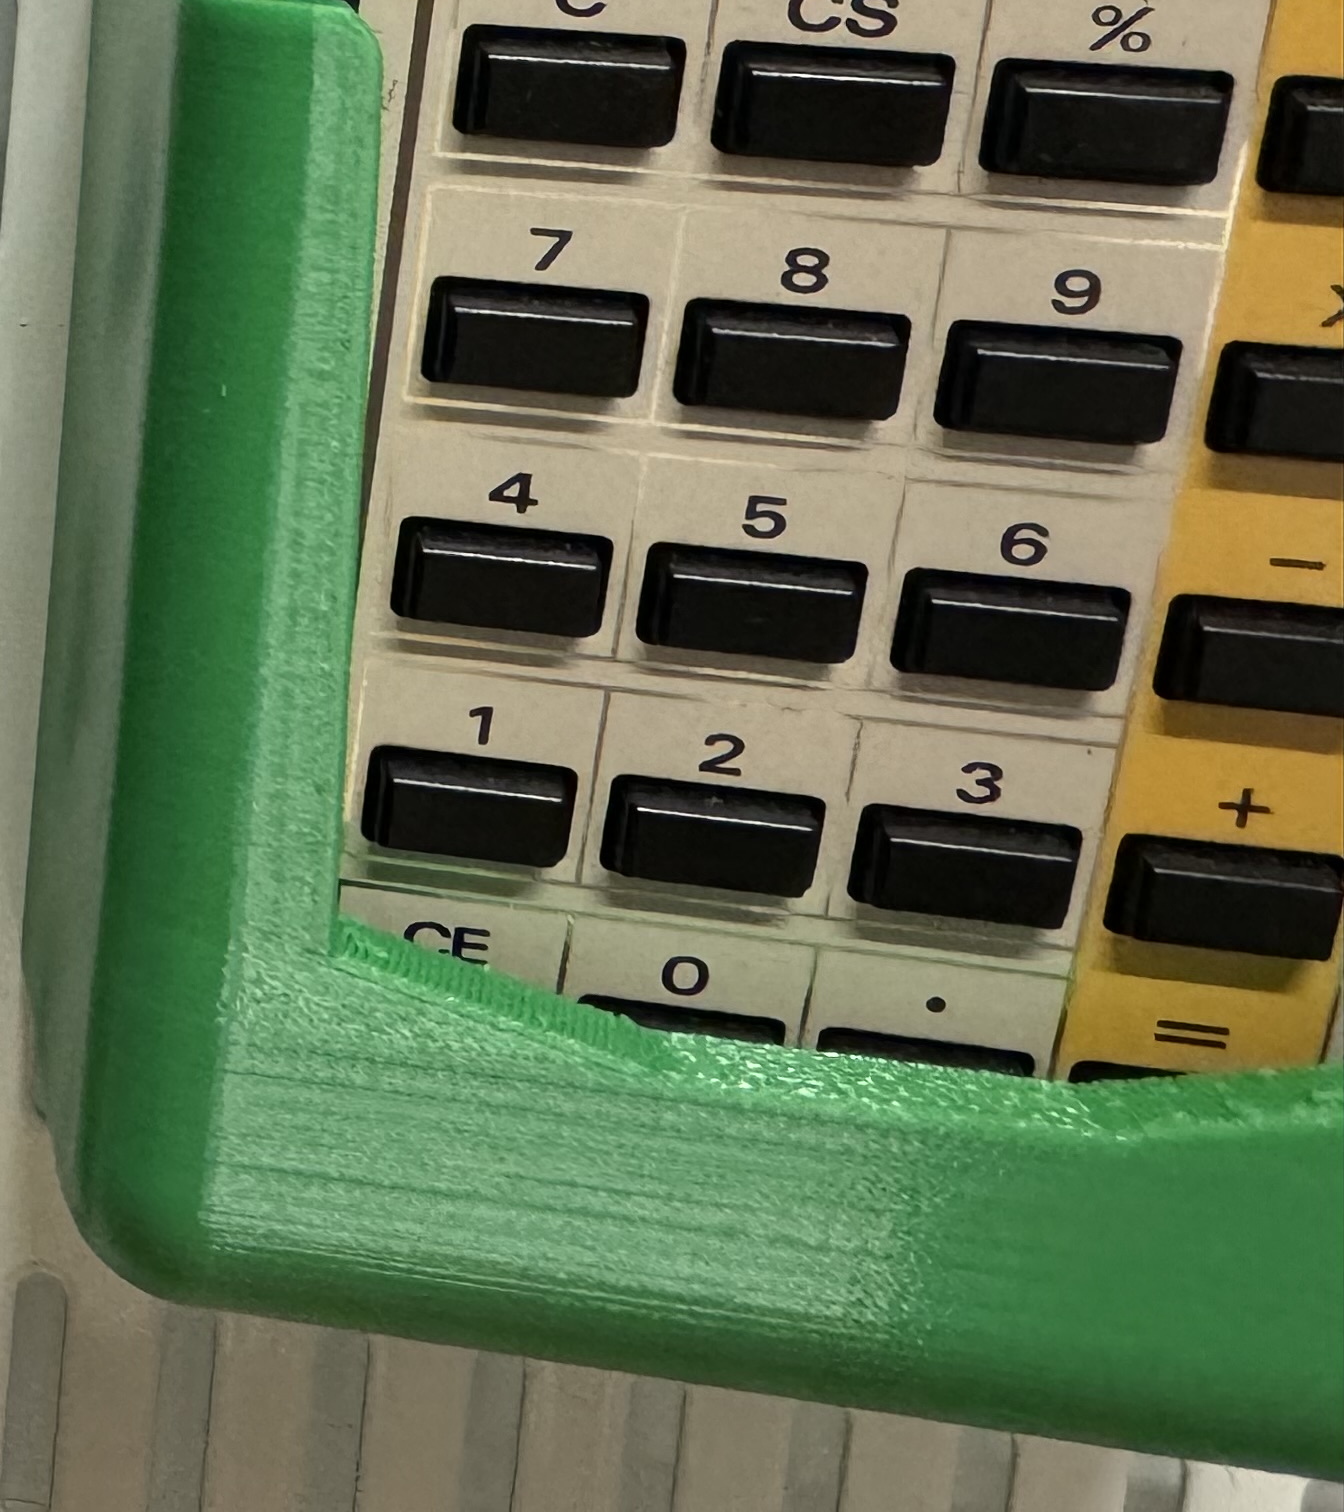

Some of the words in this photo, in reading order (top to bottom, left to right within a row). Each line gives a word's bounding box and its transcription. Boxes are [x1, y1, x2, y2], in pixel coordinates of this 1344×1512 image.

[1089, 4, 1155, 54] %
[529, 226, 574, 272] 7
[779, 246, 831, 295] 8
[1050, 268, 1103, 317] 9
[487, 471, 540, 515] 4
[740, 494, 788, 540] 5
[999, 521, 1051, 567] 6
[468, 705, 495, 746] 1
[697, 732, 747, 778] 2
[955, 760, 1005, 806] 3
[660, 954, 711, 996] 0
